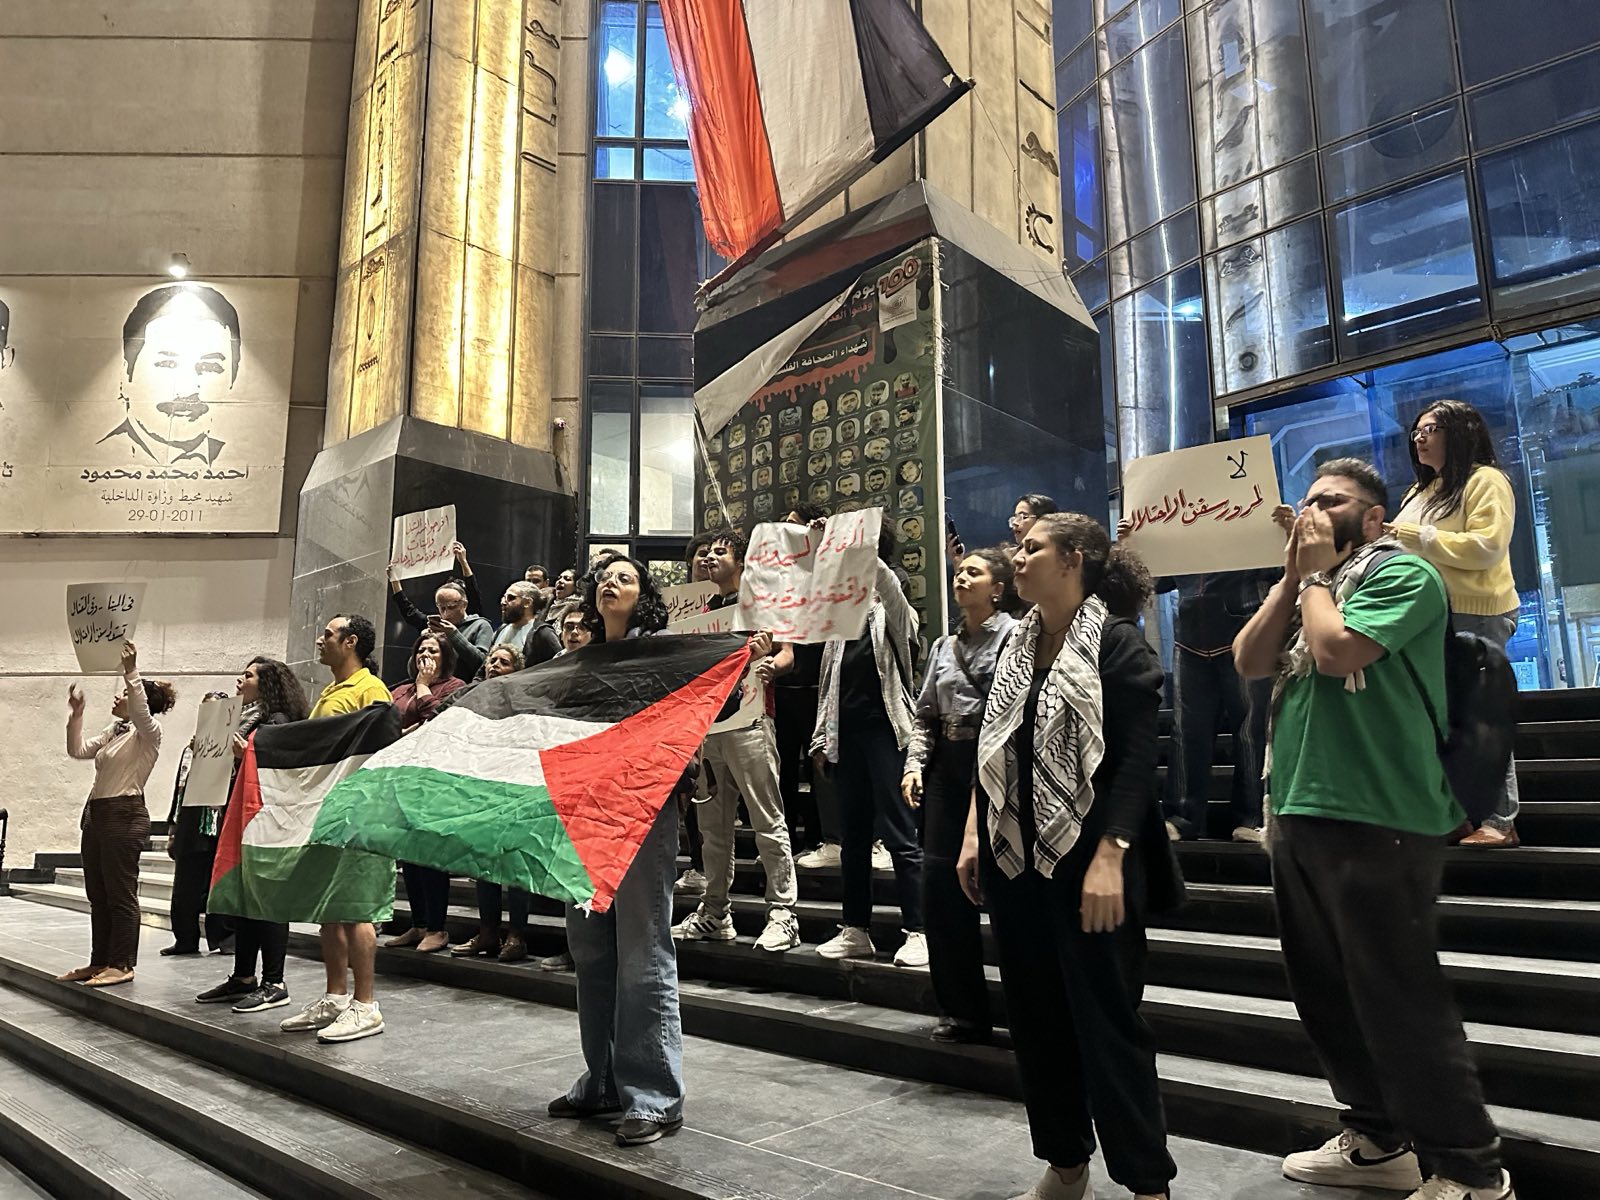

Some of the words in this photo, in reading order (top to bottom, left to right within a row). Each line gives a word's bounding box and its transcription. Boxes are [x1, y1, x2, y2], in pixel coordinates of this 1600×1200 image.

[879, 257, 919, 298] 100
[851, 283, 876, 305] يوم
[840, 338, 868, 357] شهداء
[801, 348, 838, 368] الصحافة
[775, 360, 799, 376] الفلس
[202, 463, 249, 480] احمد
[1226, 450, 1248, 479] لا
[80, 468, 142, 483] محمود
[145, 468, 199, 480] محمد
[100, 488, 143, 505] الداخلية
[147, 488, 173, 505] وزارة
[178, 488, 202, 505] محيط
[204, 491, 233, 506] شهيد
[1213, 483, 1264, 522] لمرور
[127, 509, 203, 522] 29-01-2011
[1126, 488, 1186, 532] الاحتلال
[1181, 497, 1230, 527] سفن
